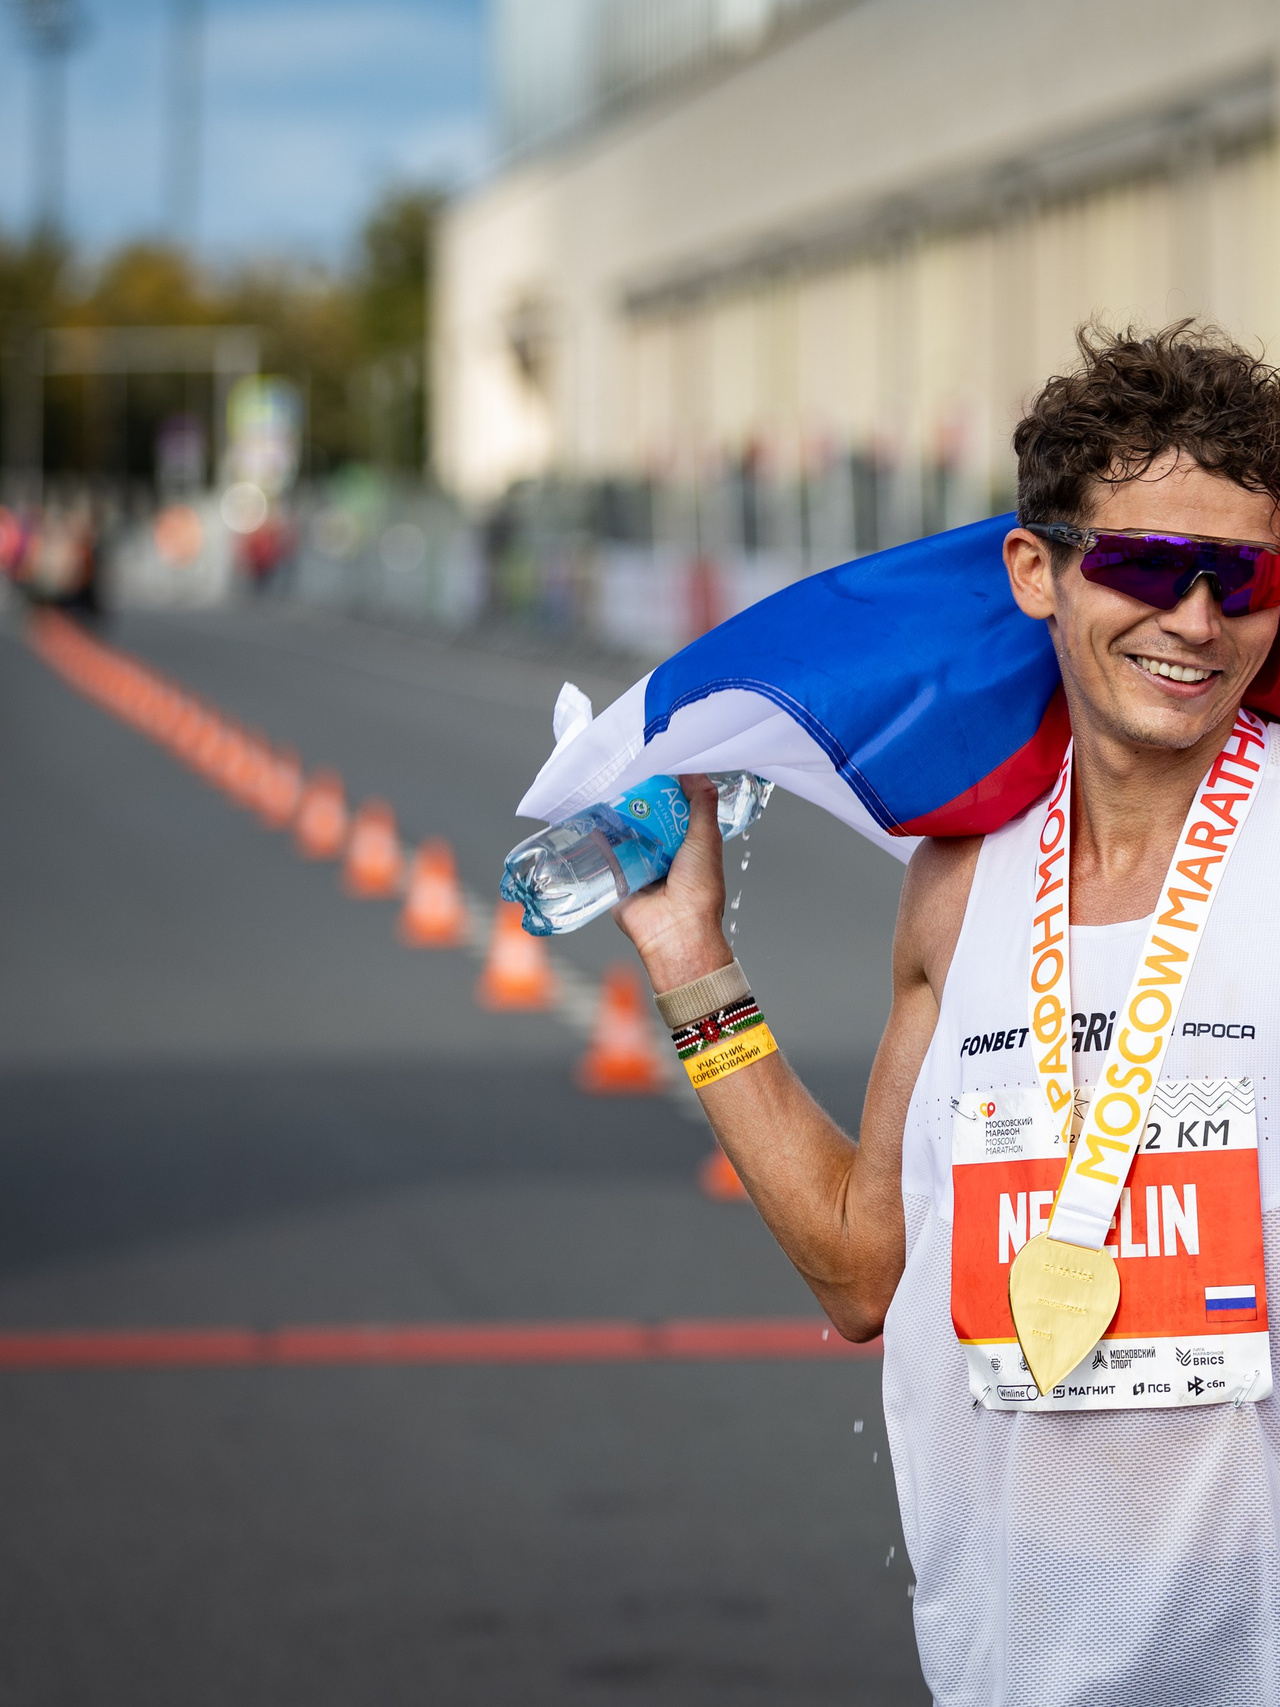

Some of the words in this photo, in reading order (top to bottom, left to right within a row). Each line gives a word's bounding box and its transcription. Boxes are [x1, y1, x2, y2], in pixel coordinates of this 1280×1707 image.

[960, 1027, 1029, 1058] FONBET
[696, 1043, 746, 1071] УЧАСТНИК
[1075, 935, 1190, 1186] MOSCOW
[692, 1046, 761, 1084] СОРЕВНОВАНИЙ
[985, 1117, 1033, 1128] МОСКОВСКИЙ
[985, 1127, 1020, 1137] МАРАФОН
[985, 1136, 1017, 1146] MOSCOW
[985, 1145, 1024, 1155] MARATHON
[1109, 1347, 1157, 1360] МОСКОВСКИЙ
[1110, 1360, 1133, 1370] СПОРТ
[1193, 1356, 1226, 1367] BRICS
[1147, 1383, 1171, 1394] ПСБ
[1206, 1380, 1226, 1389] сбп
[1000, 1388, 1026, 1398] Winline
[1068, 1385, 1116, 1396] МАГНИТ
